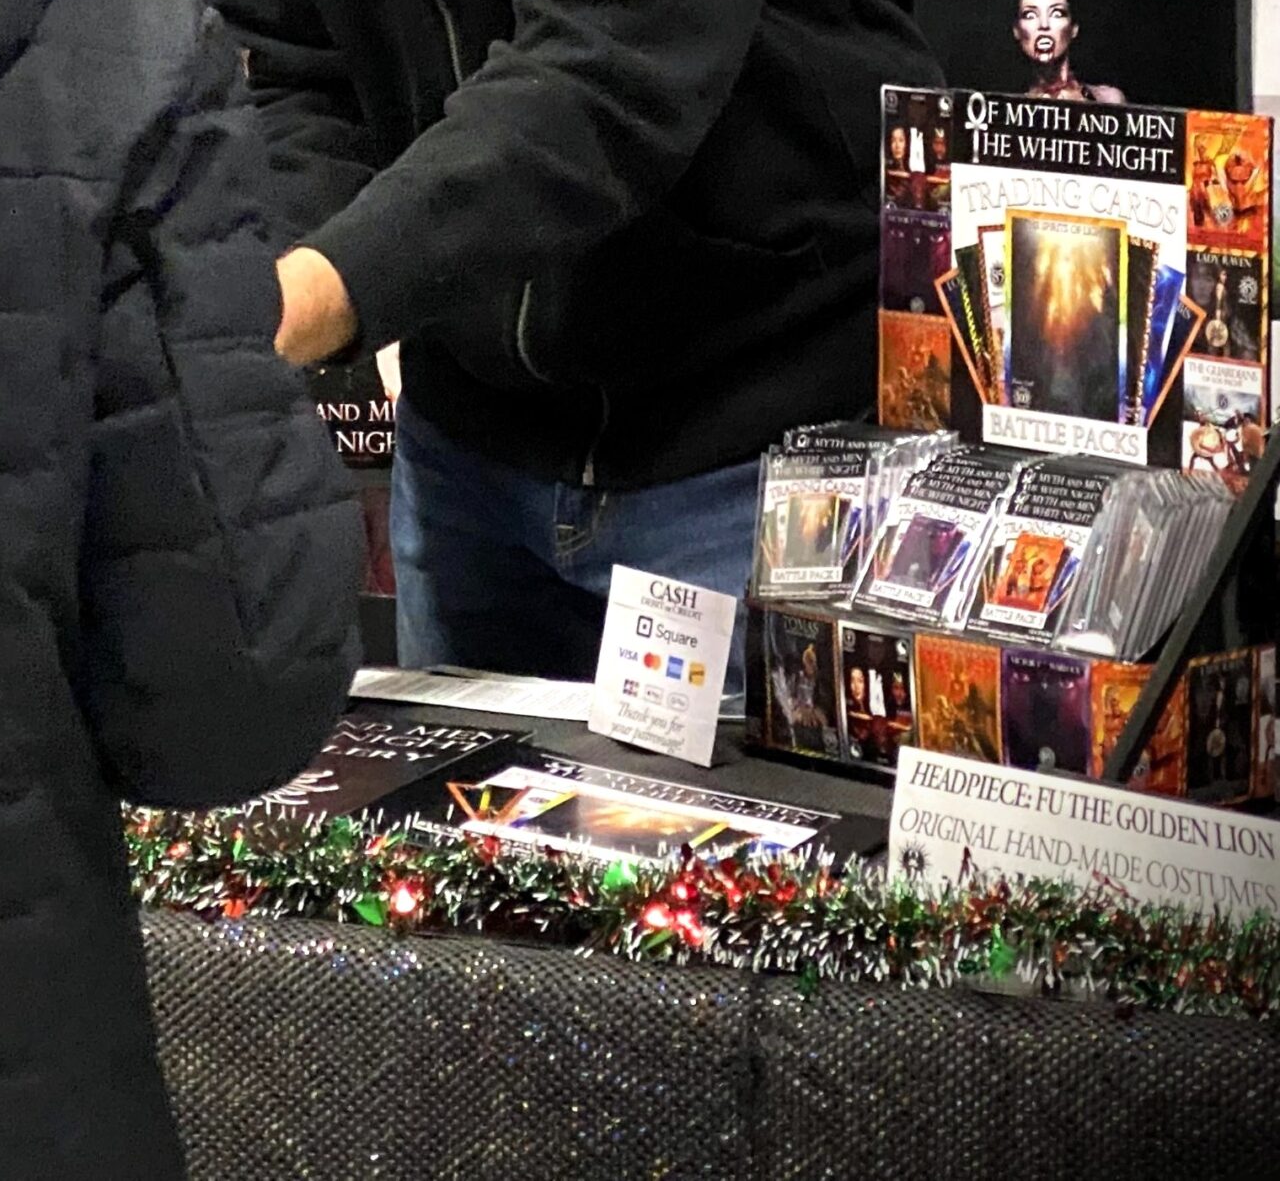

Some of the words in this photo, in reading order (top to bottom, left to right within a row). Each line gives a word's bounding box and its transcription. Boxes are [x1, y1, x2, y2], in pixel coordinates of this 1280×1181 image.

[1005, 103, 1071, 131] MYTH
[1077, 113, 1119, 136] AND
[1125, 113, 1175, 141] MEN
[1018, 135, 1091, 166] WHITE
[1096, 143, 1174, 173] NIGHT
[960, 177, 1082, 213] TRADING
[1089, 183, 1179, 235] CARDS
[1196, 253, 1218, 264] LADY
[316, 403, 360, 421] AND
[815, 438, 845, 448] MYTH
[989, 412, 1067, 447] BATTLE
[1071, 426, 1140, 458] PACKS
[656, 623, 699, 648] Square
[620, 648, 638, 662] VISA
[336, 720, 393, 731] ND
[618, 702, 650, 723] Thank
[667, 720, 685, 735] for
[322, 745, 436, 762] LERY
[333, 731, 478, 752] NIGHT
[909, 760, 1033, 809] HEADPIECE:
[1036, 787, 1069, 817] FU
[1069, 794, 1113, 826] THE
[1116, 803, 1210, 847] GOLDEN
[1215, 822, 1278, 860] LION
[899, 806, 1001, 852] ORIGINAL
[1004, 829, 1143, 885] HAND-MADE
[1146, 863, 1279, 912] COSTUMES
